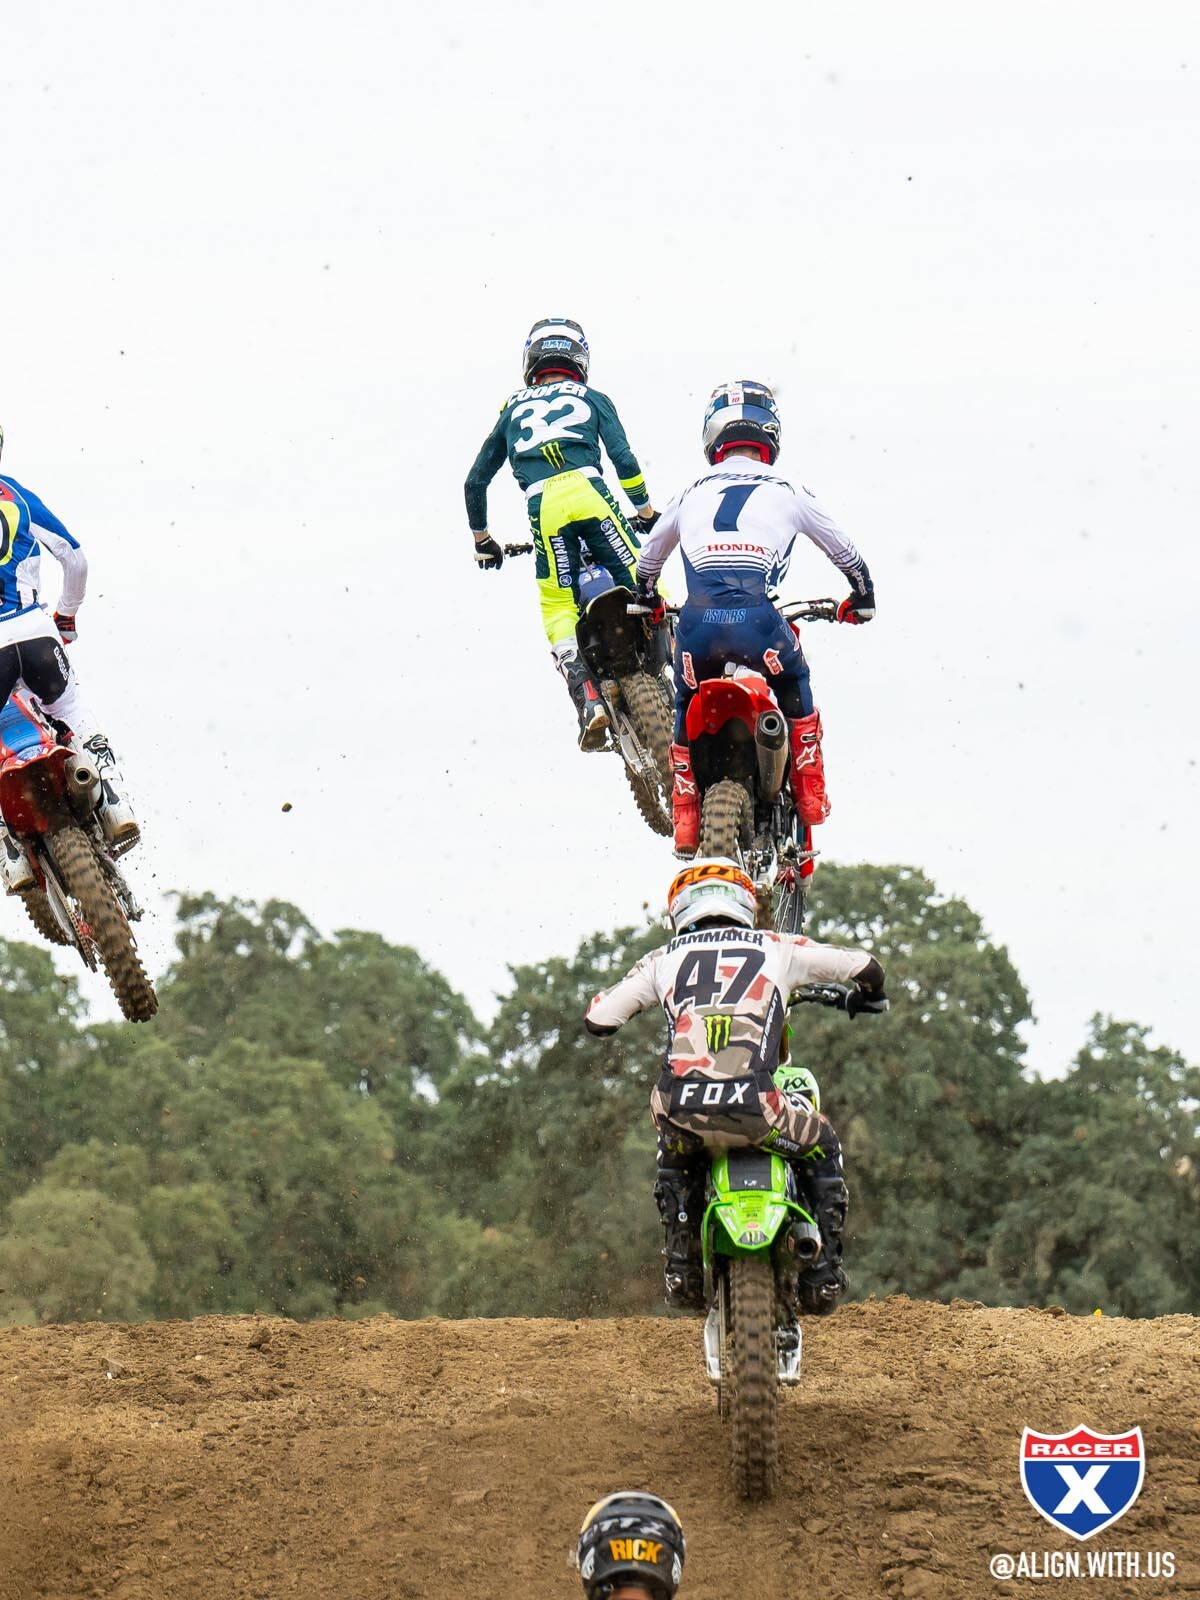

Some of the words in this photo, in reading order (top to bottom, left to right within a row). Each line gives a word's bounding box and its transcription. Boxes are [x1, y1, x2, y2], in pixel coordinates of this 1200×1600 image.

[541, 339, 572, 350] JUSTIN
[506, 381, 587, 408] COOPER
[511, 395, 592, 452] 32
[712, 484, 763, 532] 1
[551, 536, 570, 575] YAMAHA
[606, 527, 636, 568] YAMAHA
[707, 543, 766, 555] HONDA
[702, 608, 747, 624] ASTARS
[666, 928, 764, 955] HAMMAKER
[673, 948, 766, 1008] 47
[679, 1082, 750, 1106] FOX
[608, 1538, 664, 1565] RICK
